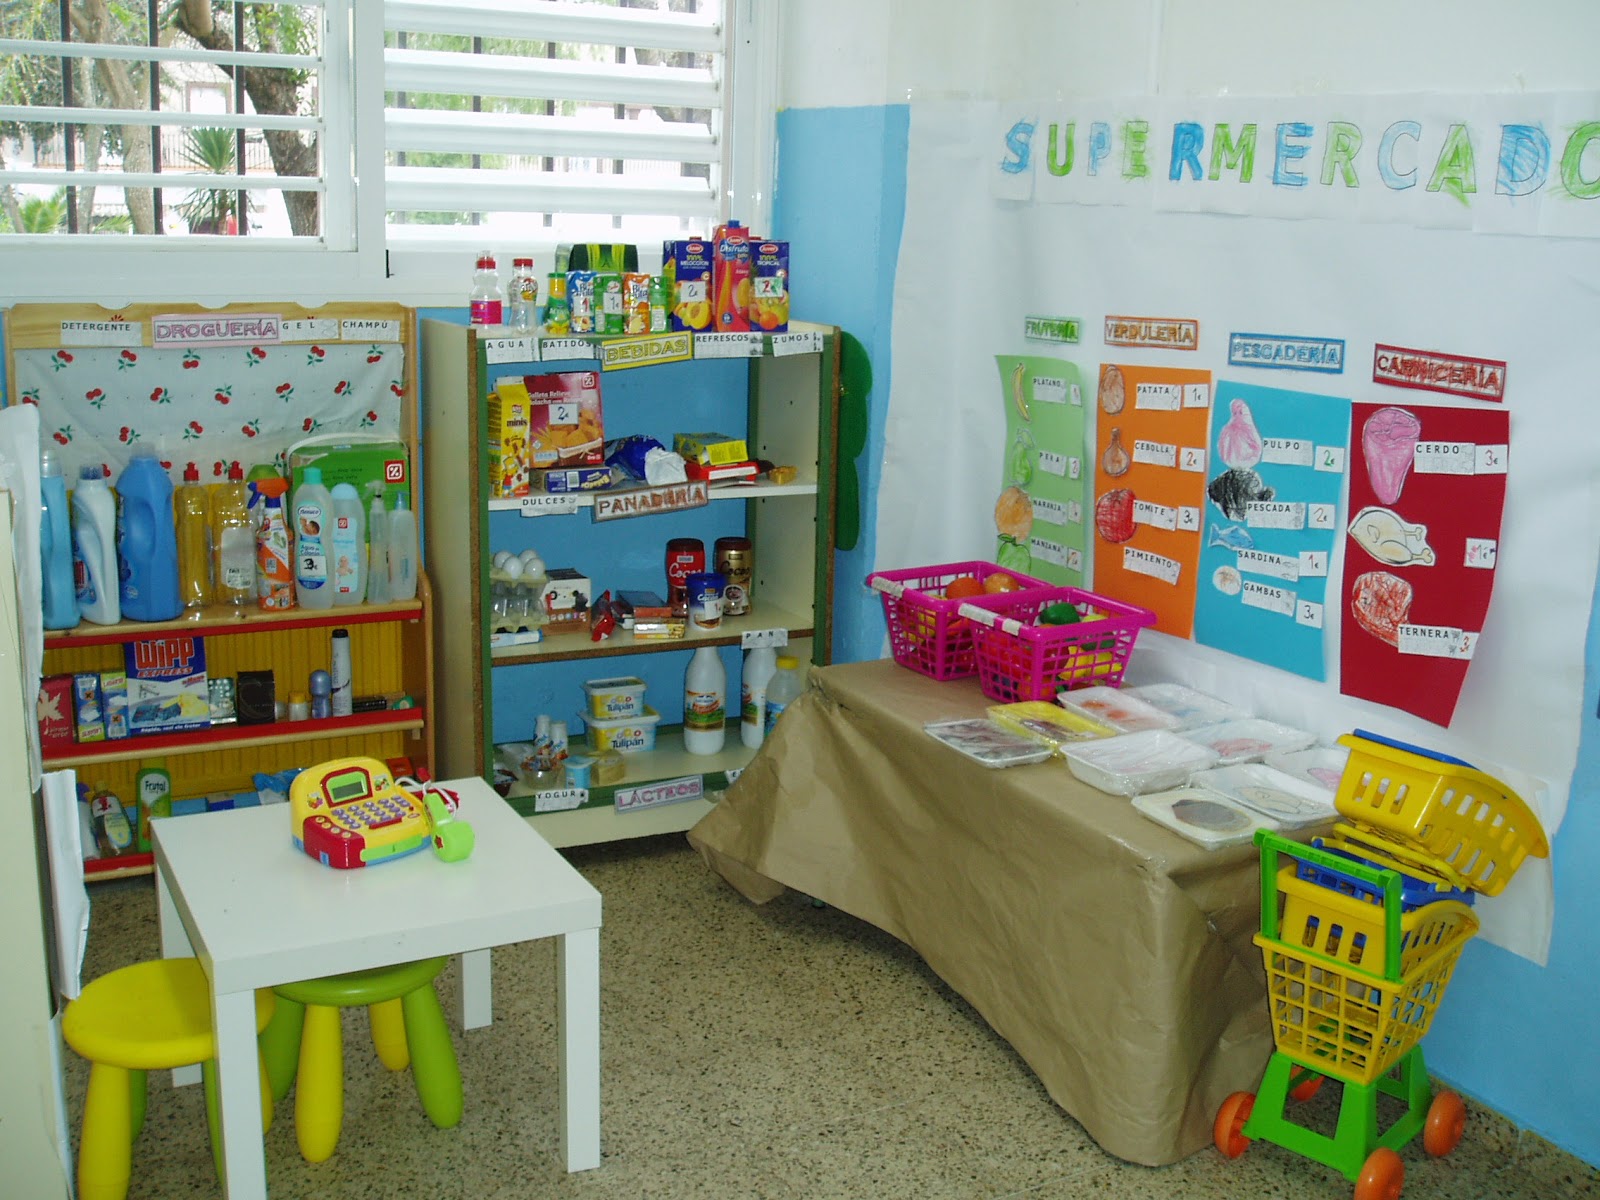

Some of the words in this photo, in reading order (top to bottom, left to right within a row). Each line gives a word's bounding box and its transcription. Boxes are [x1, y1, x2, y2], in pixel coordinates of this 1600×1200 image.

[1000, 119, 1600, 200] SUPERMERCADO
[61, 321, 131, 332] DETERGENTE
[156, 318, 277, 339] DROGUERÍA
[282, 321, 316, 331] GEL
[342, 320, 389, 330] CHAMPÚ
[1105, 320, 1194, 343] VERDULERÍA
[487, 340, 524, 350] AGUA
[542, 339, 592, 349] BATIDOS
[696, 334, 749, 343] REFRESCOS
[773, 334, 809, 344] ZUMOS
[606, 338, 687, 362] BEBIDAS
[1233, 341, 1340, 366] PESCADERÍA
[1137, 385, 1170, 394] PATATA
[1192, 387, 1202, 402] 1€
[506, 418, 528, 428] minis
[1134, 442, 1169, 453] CEBOLLA
[1263, 440, 1301, 450] PULPO
[1416, 444, 1460, 454] CERDO
[1186, 451, 1197, 467] 2€
[1323, 449, 1336, 468] 2€
[1485, 450, 1499, 466] 3€
[522, 497, 566, 506] DULCES
[600, 484, 705, 514] PANADERÍA
[1247, 503, 1291, 513] PESCADA
[1313, 507, 1328, 523] 2€
[1125, 548, 1173, 569] PIMIENTO
[1238, 550, 1282, 565] SARDINA
[1308, 553, 1319, 570] 1€
[1243, 582, 1282, 599] GAMBAS
[1303, 604, 1315, 620] 3€
[745, 631, 775, 640] PAN
[1400, 626, 1449, 639] TERNERA
[607, 702, 634, 713] Tulipán
[611, 737, 644, 750] Tulipán
[537, 789, 576, 799] YOGUR
[617, 780, 700, 808] LÁCTEOS
